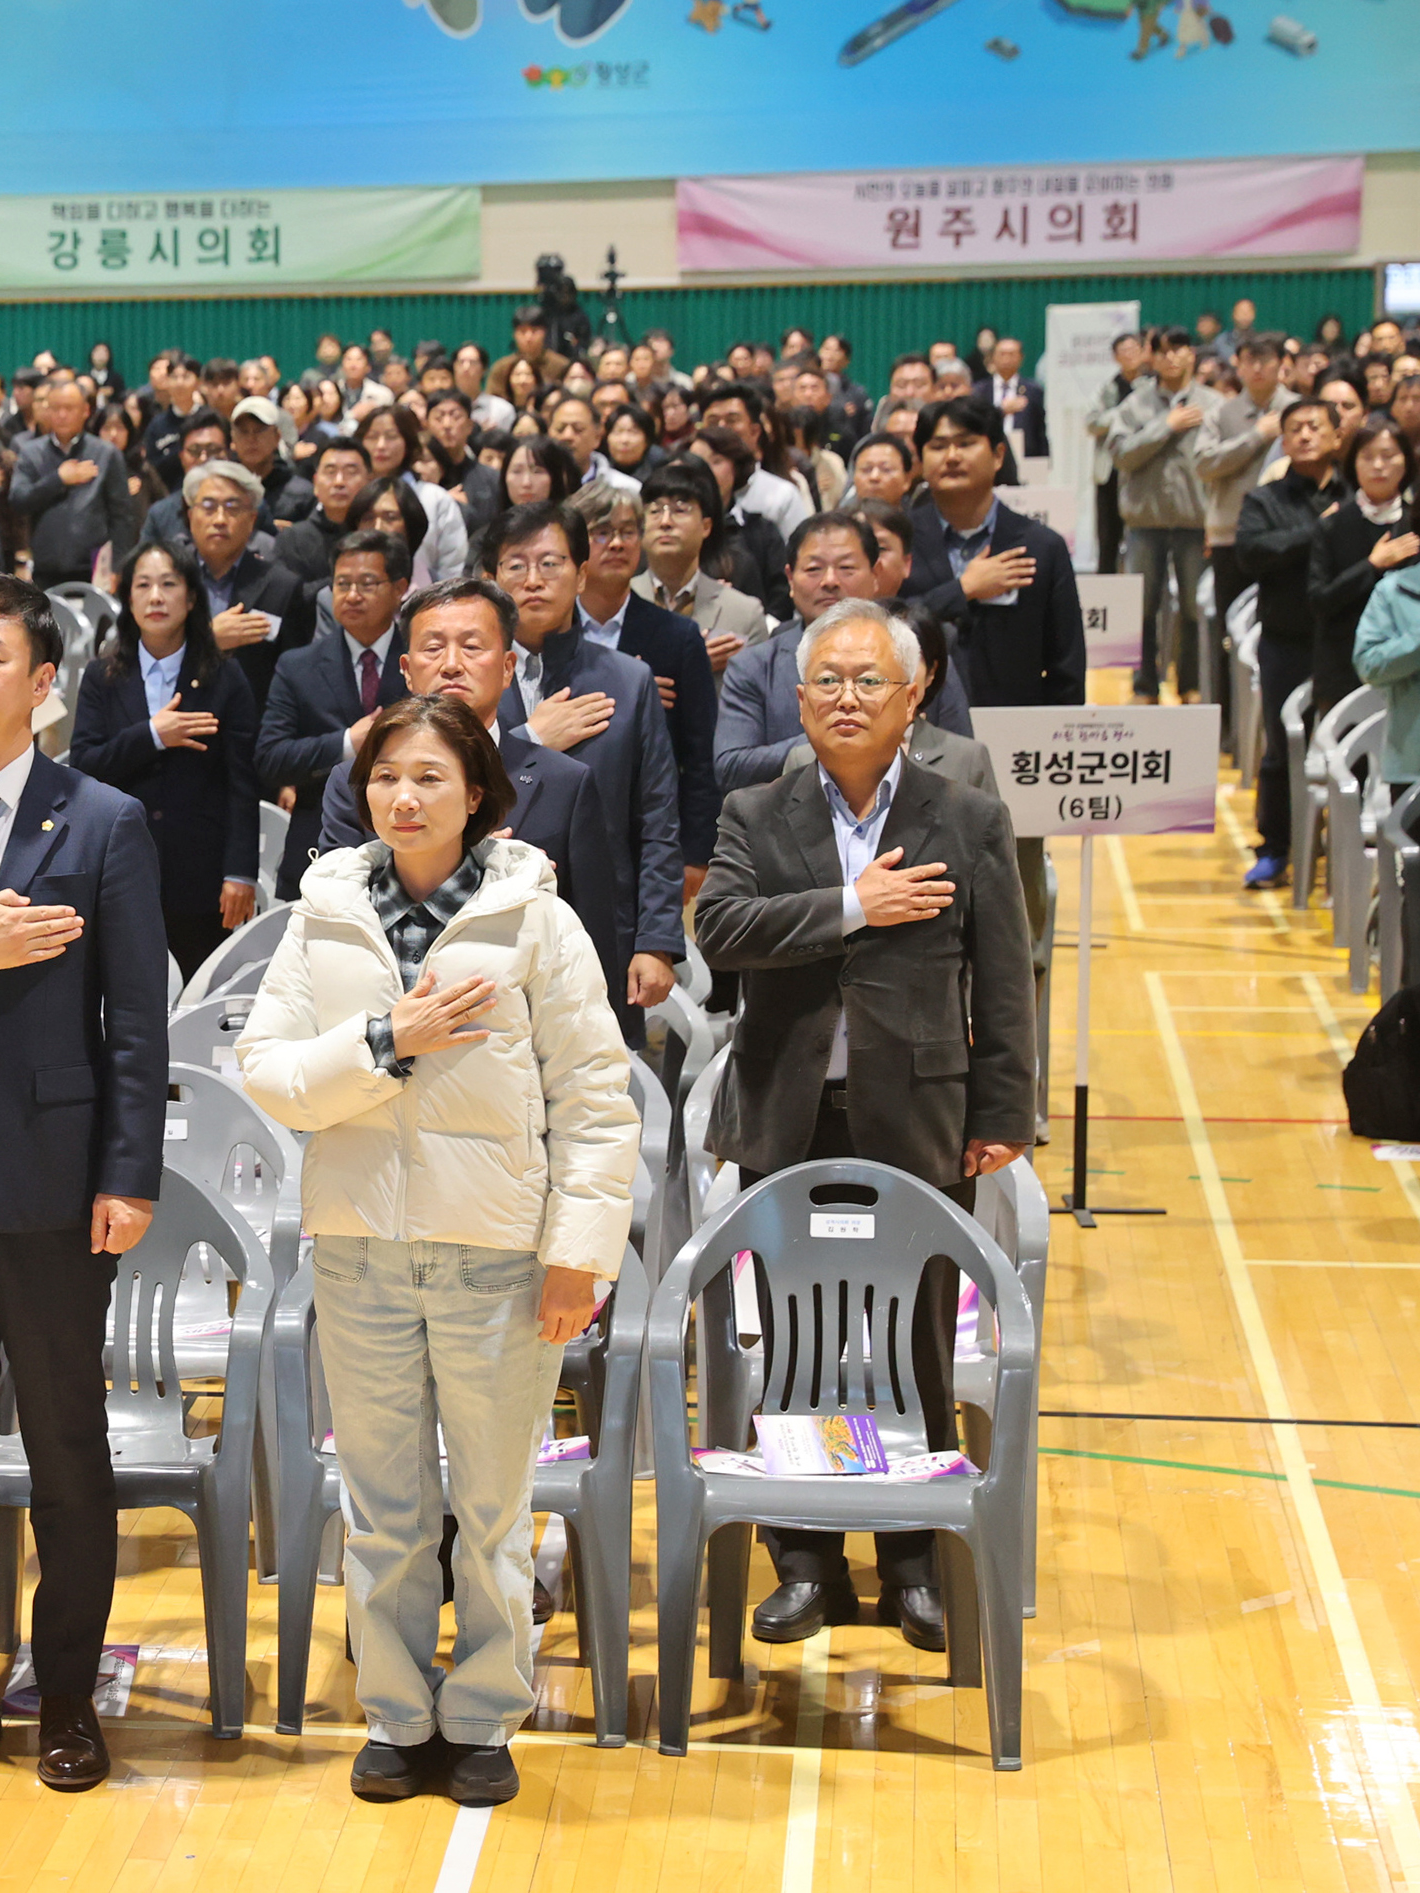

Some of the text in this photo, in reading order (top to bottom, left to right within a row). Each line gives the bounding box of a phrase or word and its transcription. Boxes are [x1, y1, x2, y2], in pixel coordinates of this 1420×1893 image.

[885, 201, 1138, 249] 원주시의회
[48, 224, 281, 271] 강릉시의회
[1011, 750, 1171, 785] 횡성군의회
[1058, 796, 1122, 821] (6팀)
